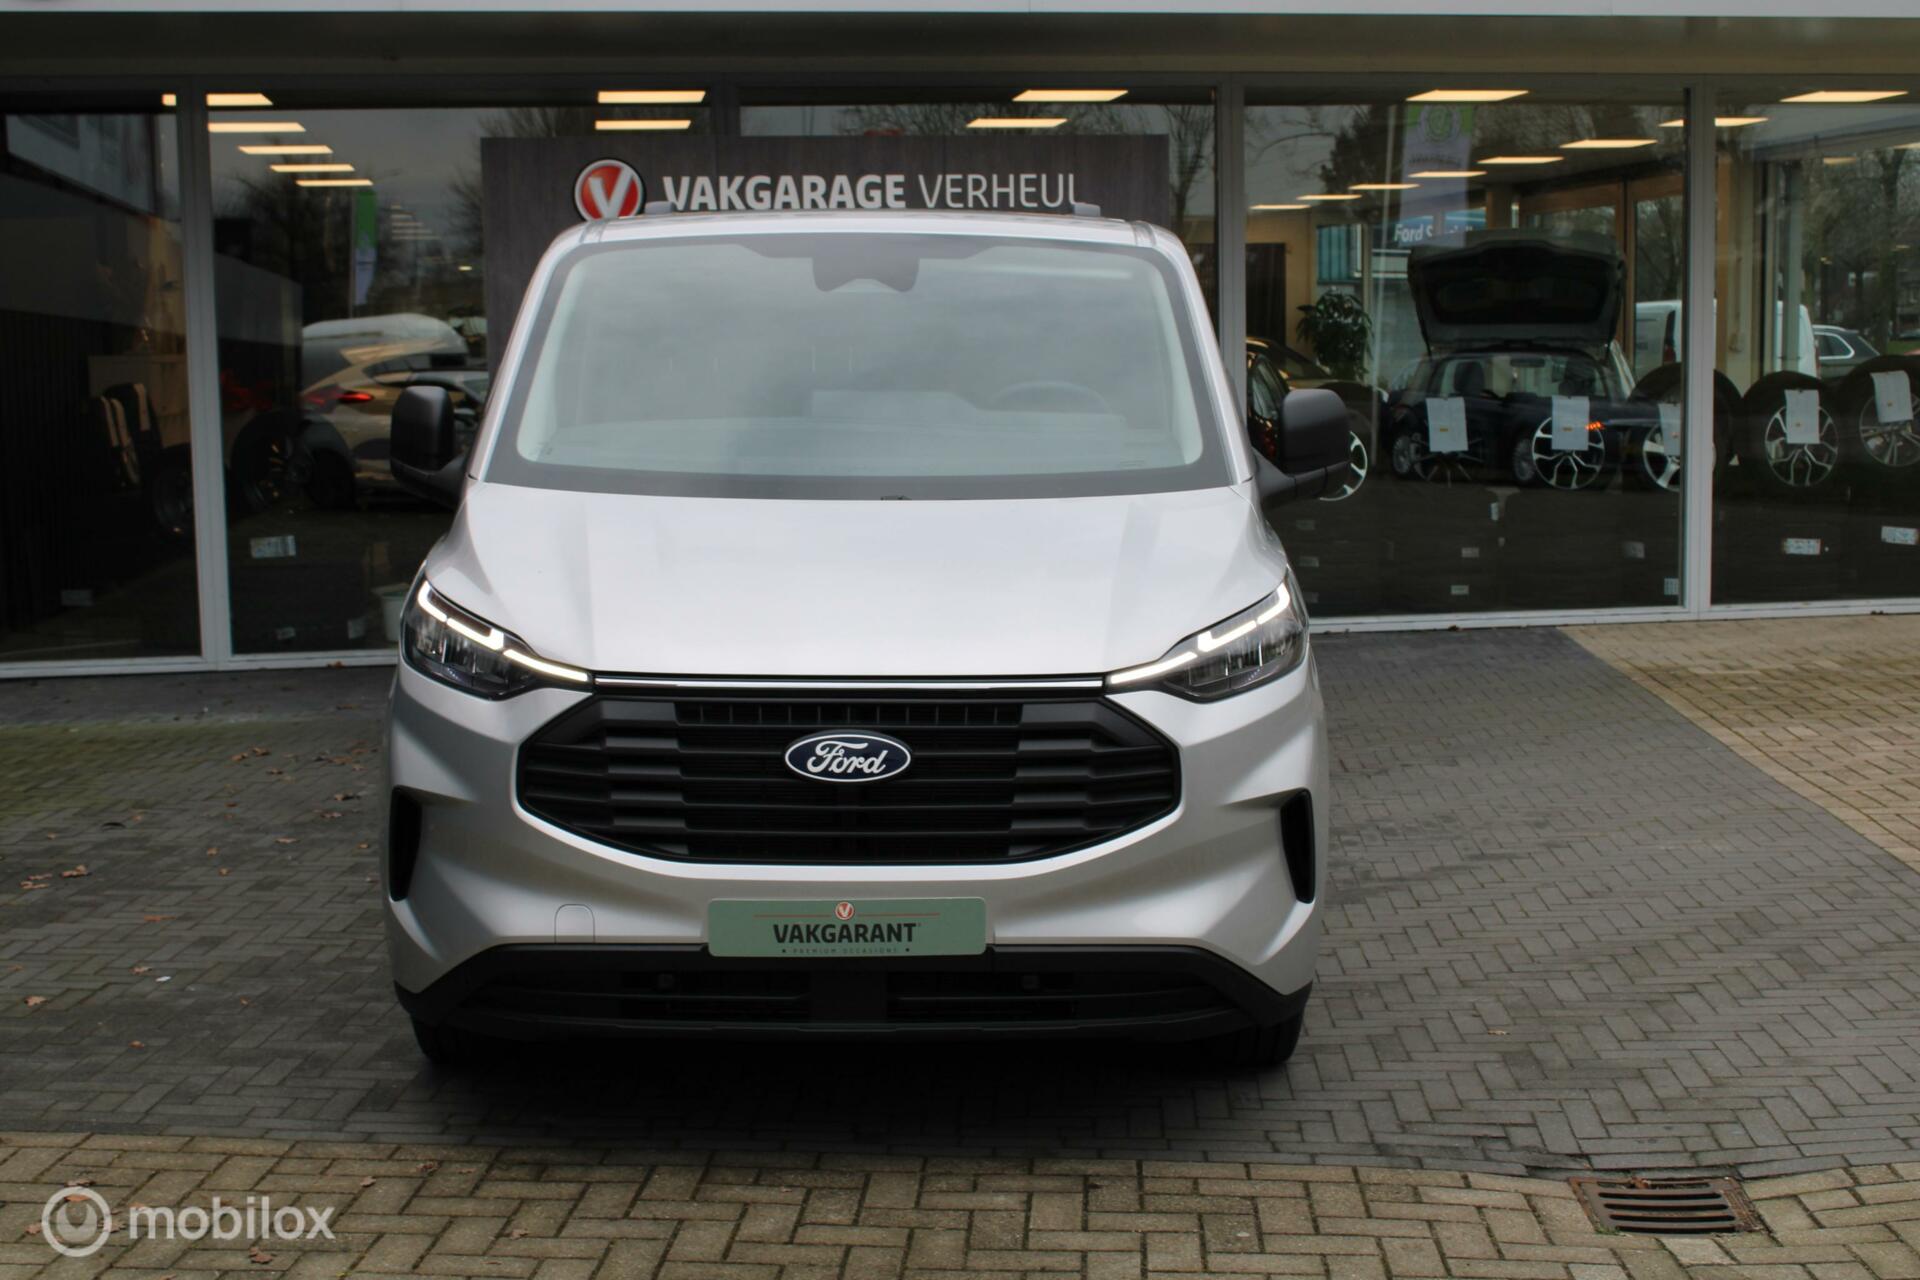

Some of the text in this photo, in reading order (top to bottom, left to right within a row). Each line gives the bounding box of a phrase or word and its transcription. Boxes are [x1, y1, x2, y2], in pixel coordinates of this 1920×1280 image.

[663, 174, 1077, 210] VAKGARAGE VERHEUL
[1393, 223, 1424, 242] Ford
[807, 740, 888, 773] Ford
[773, 922, 917, 943] VAKGARANT
